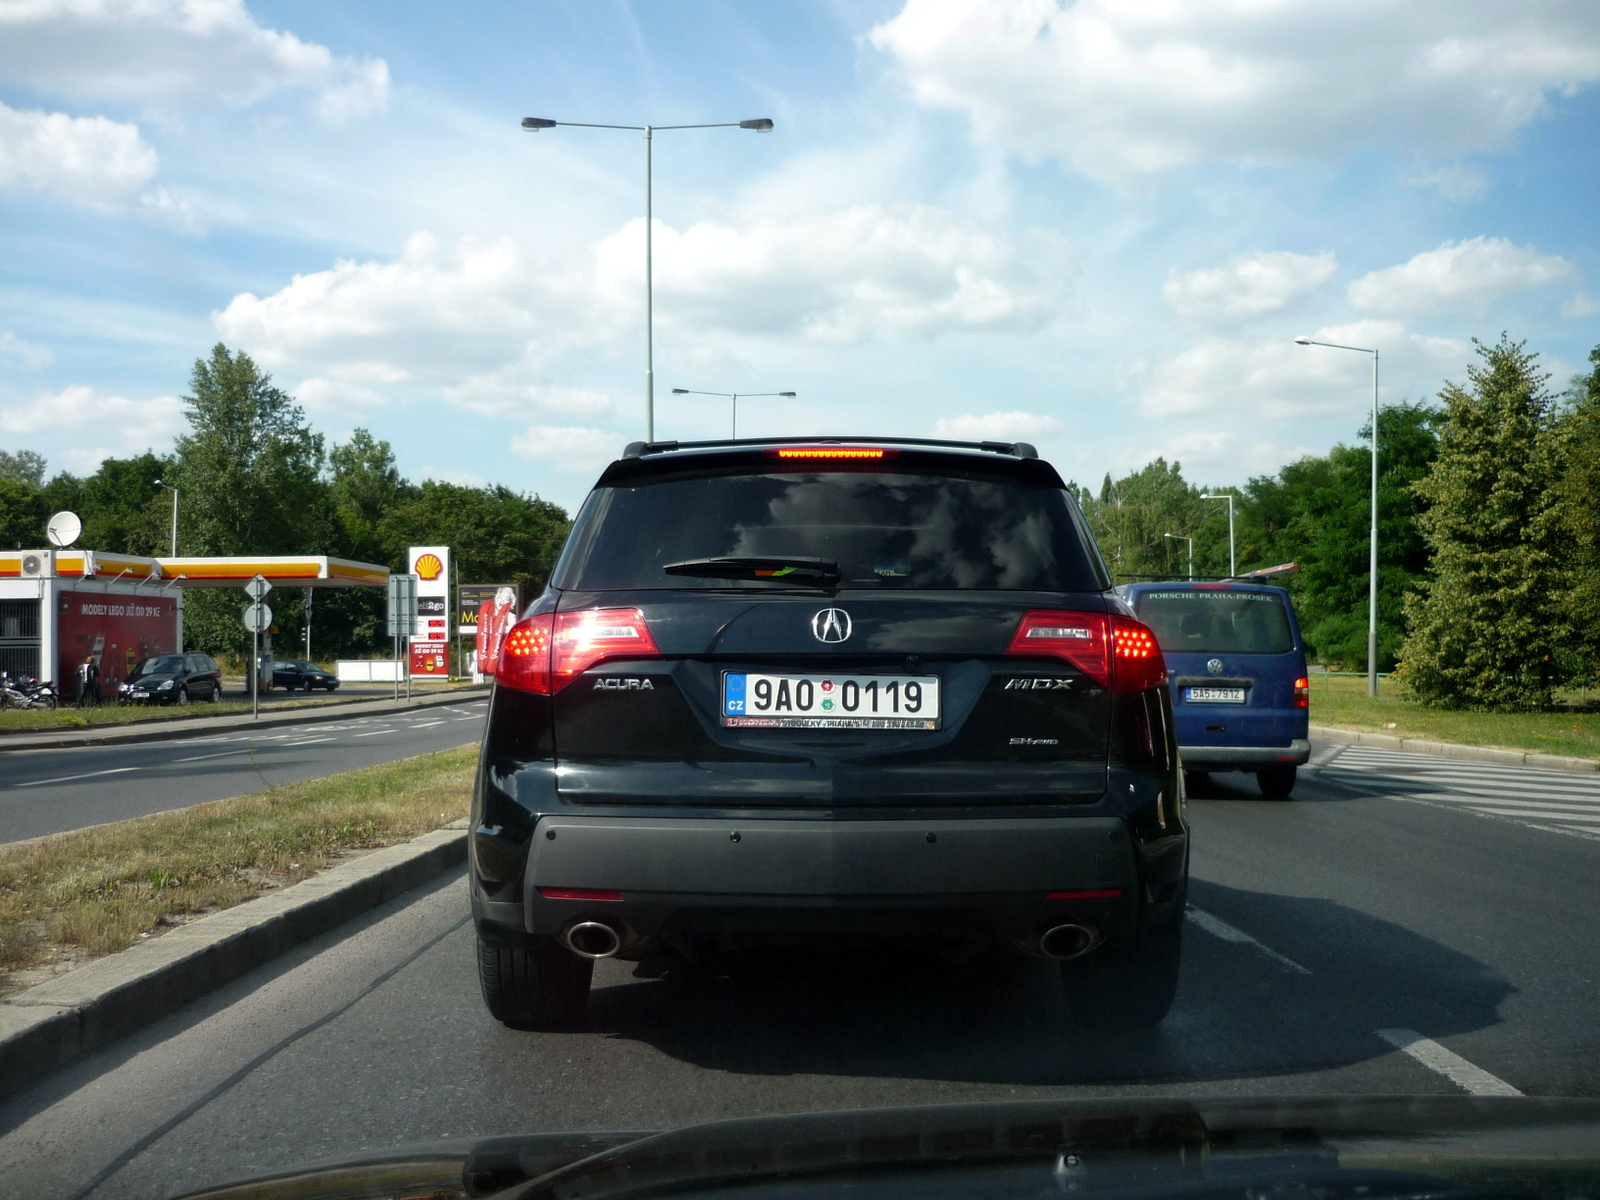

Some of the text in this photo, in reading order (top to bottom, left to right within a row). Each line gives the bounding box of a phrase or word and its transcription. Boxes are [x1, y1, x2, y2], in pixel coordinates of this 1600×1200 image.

[1199, 593, 1273, 602] PRAHA-PROSEK
[82, 604, 108, 615] MODELY
[108, 605, 125, 616] LEGO
[136, 606, 144, 616] OD
[146, 606, 152, 617] 29
[418, 602, 444, 611] eli2go
[593, 679, 655, 690] ACURA
[1004, 678, 1074, 690] MDX
[842, 679, 922, 713] 0119
[1193, 689, 1240, 699] 5A5 7912
[728, 701, 744, 711] CZ
